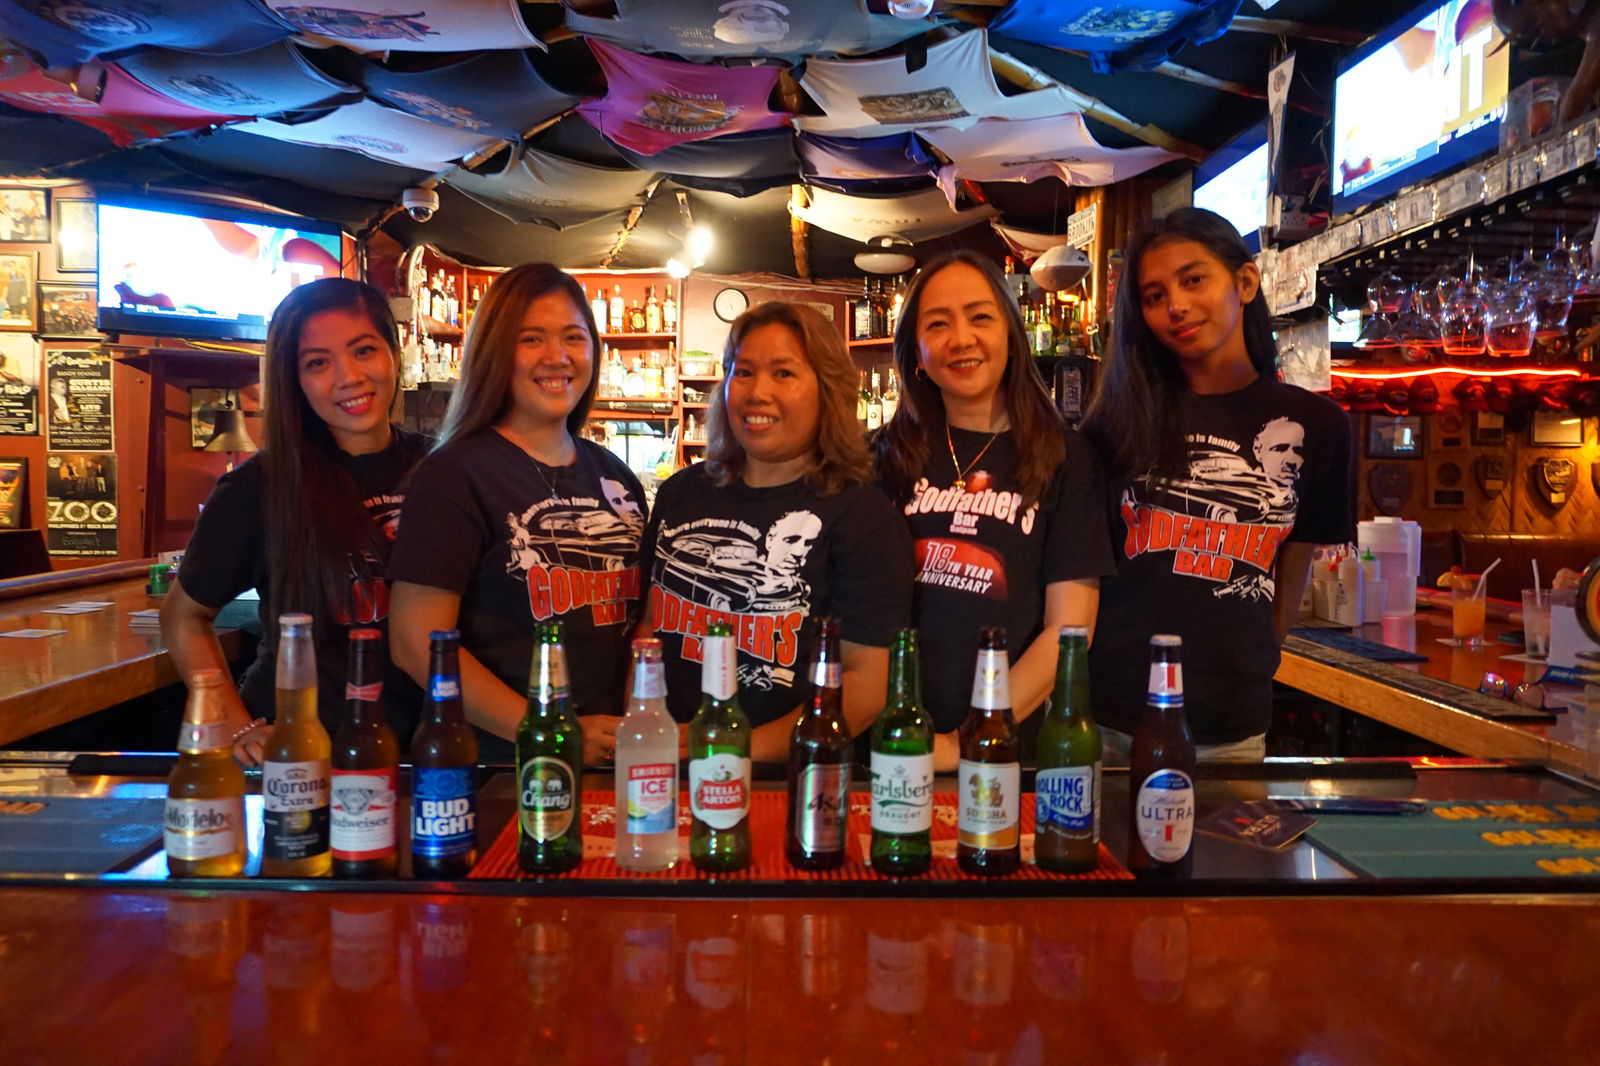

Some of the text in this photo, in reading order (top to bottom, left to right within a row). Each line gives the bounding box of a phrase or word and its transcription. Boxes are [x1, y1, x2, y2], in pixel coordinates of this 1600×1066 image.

[1208, 434, 1241, 452] family
[47, 501, 118, 523] ZOO
[952, 511, 980, 528] Bar
[662, 522, 690, 538] where
[690, 517, 730, 530] everyone
[737, 520, 763, 541] family
[963, 562, 994, 581] YEAR
[1172, 550, 1234, 583] BAR
[914, 571, 993, 594] ANNIVERSARY
[651, 583, 804, 668] ODFATHER'S
[266, 777, 327, 797] Corona
[640, 779, 668, 794] ICE
[702, 785, 742, 795] STELLA
[521, 789, 571, 810] Chang
[702, 793, 743, 804] ARTOIS
[1050, 795, 1083, 813] ROCK
[167, 807, 226, 828] Modelo
[422, 799, 469, 818] BUD
[1141, 805, 1193, 821] ULTRA
[415, 813, 476, 836] LIGHT
